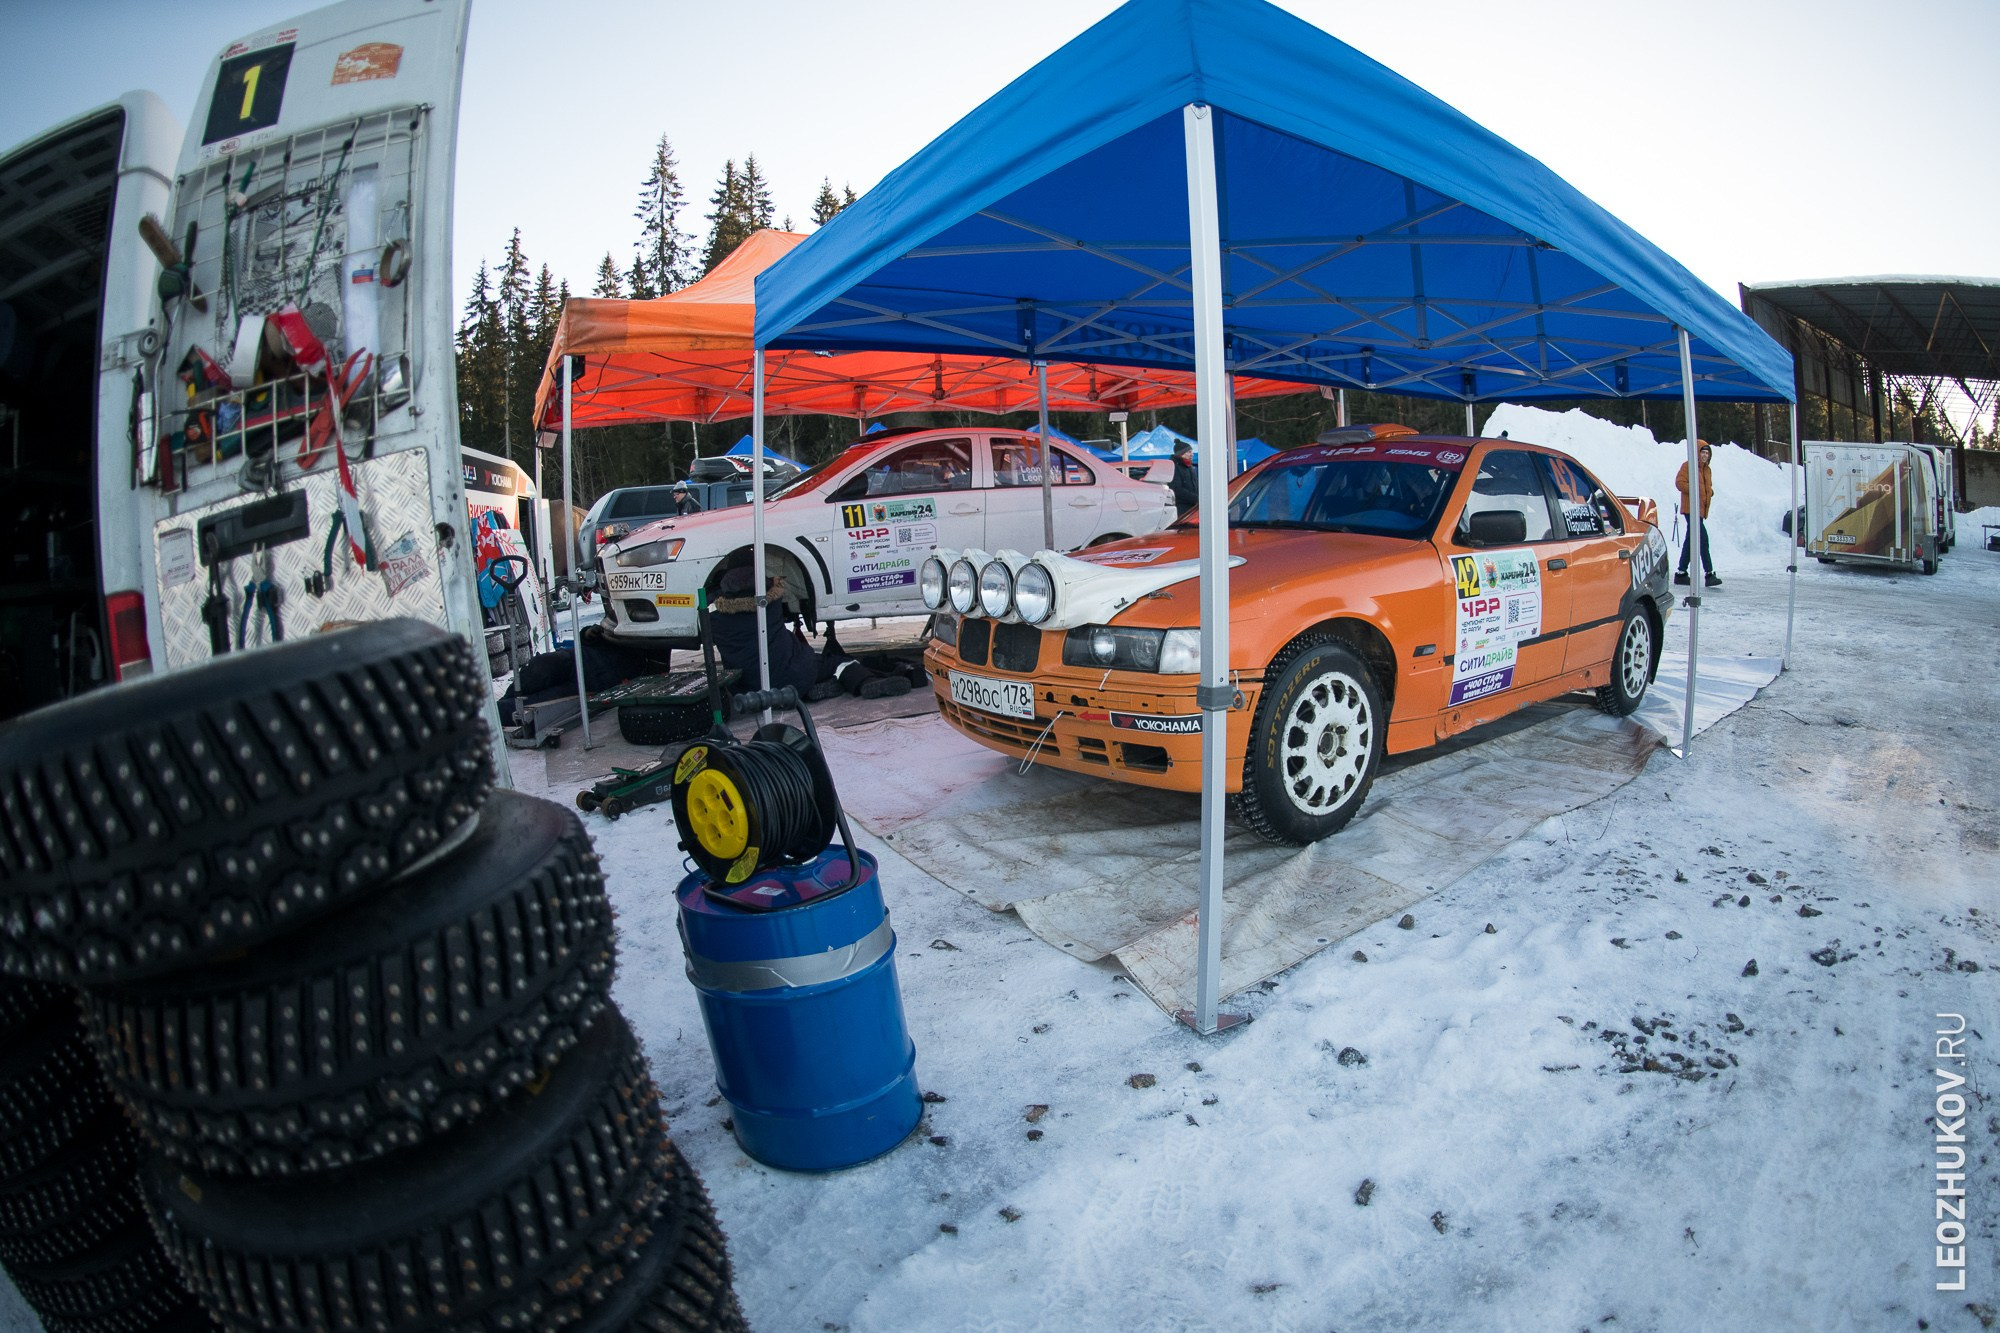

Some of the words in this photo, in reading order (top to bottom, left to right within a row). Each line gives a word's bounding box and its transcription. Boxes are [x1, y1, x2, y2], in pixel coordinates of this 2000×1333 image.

[239, 64, 262, 120] 1
[1548, 457, 1587, 505] 42
[844, 504, 864, 528] 11
[852, 558, 911, 573] СИТИДРАЙВ
[1457, 557, 1480, 597] 42
[1631, 543, 1652, 591] NEO
[609, 575, 641, 589] С959НК
[643, 573, 662, 584] 178
[658, 596, 691, 605] PIRELLI
[1460, 646, 1514, 673] СИТИДРАЙВ
[952, 677, 1000, 709] Х298ОС
[1003, 684, 1028, 705] 178
[1009, 704, 1022, 714] RUS
[1266, 656, 1321, 769] SOTTOZERO
[1135, 719, 1200, 732] YOKOHAMA
